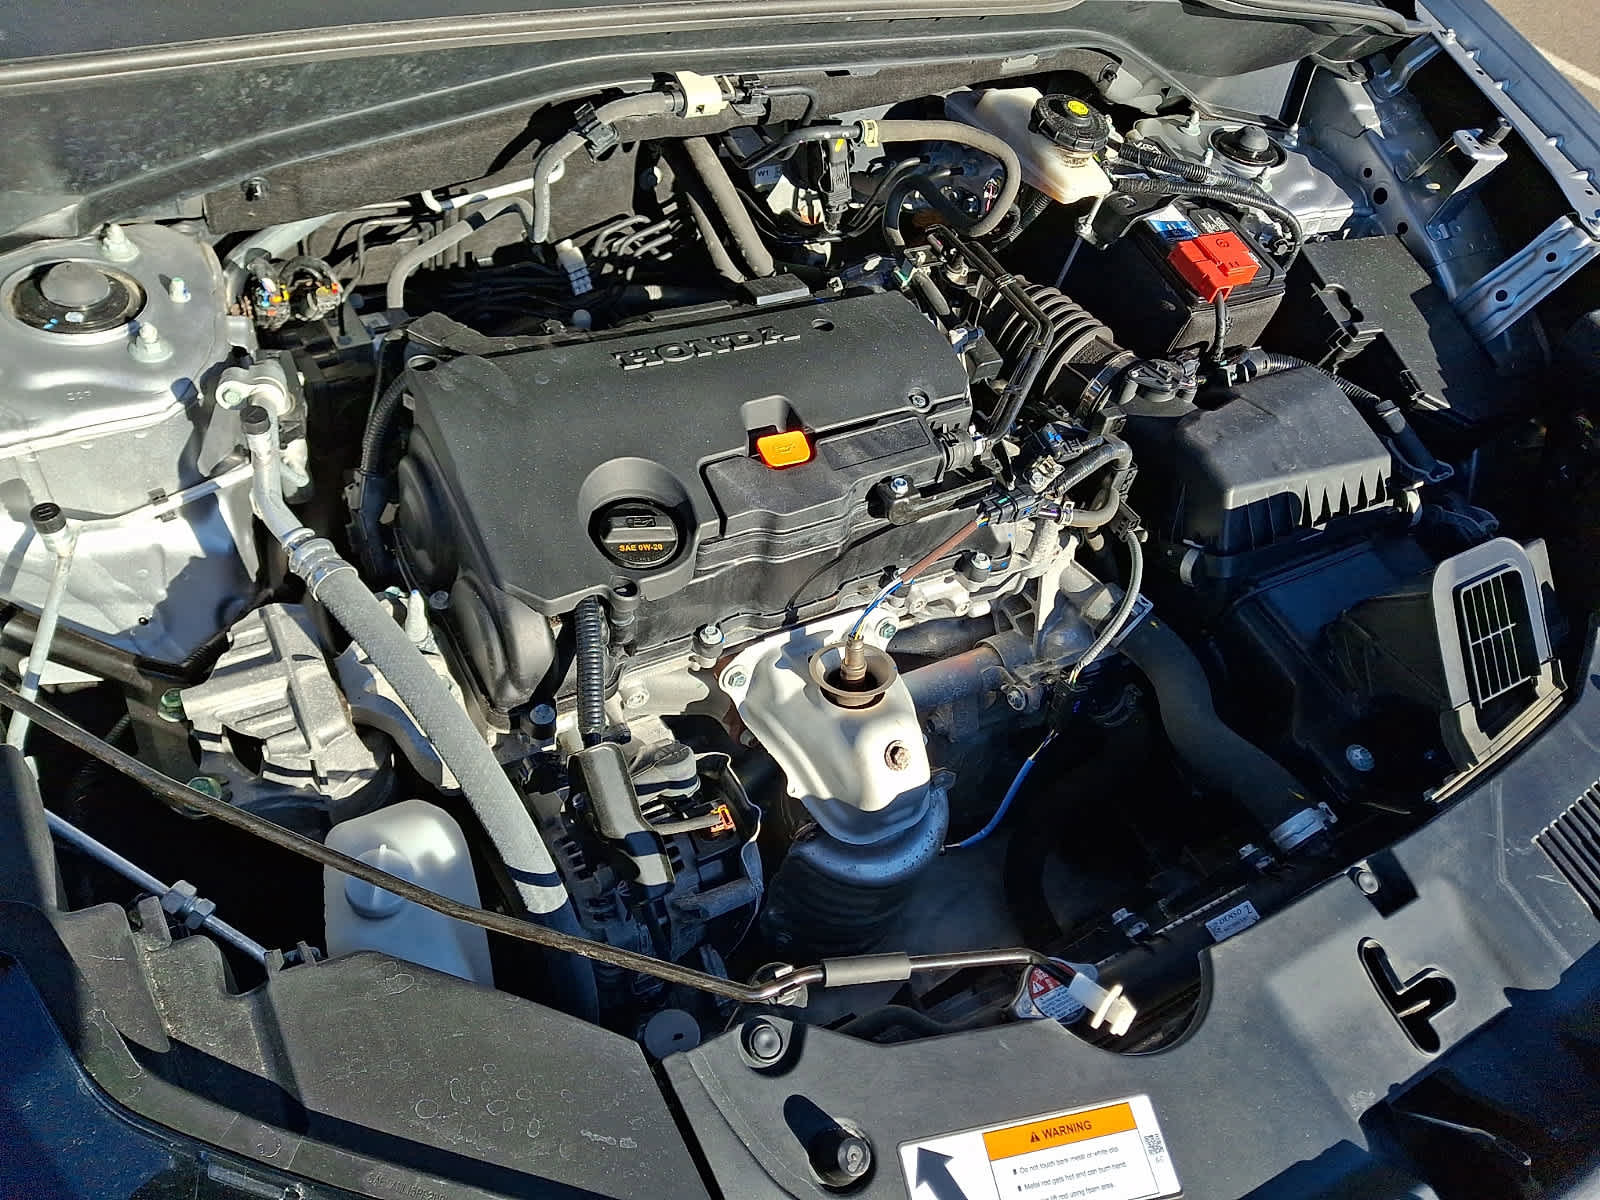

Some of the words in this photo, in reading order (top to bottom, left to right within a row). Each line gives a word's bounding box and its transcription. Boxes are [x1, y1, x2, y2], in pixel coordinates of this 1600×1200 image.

[757, 169, 769, 177] W1
[612, 325, 801, 371] HONDA
[618, 544, 637, 552] SAE
[638, 543, 664, 551] 0W-20
[1041, 1120, 1092, 1140] WARNING
[1019, 1166, 1029, 1174] Do
[1029, 1163, 1039, 1172] not
